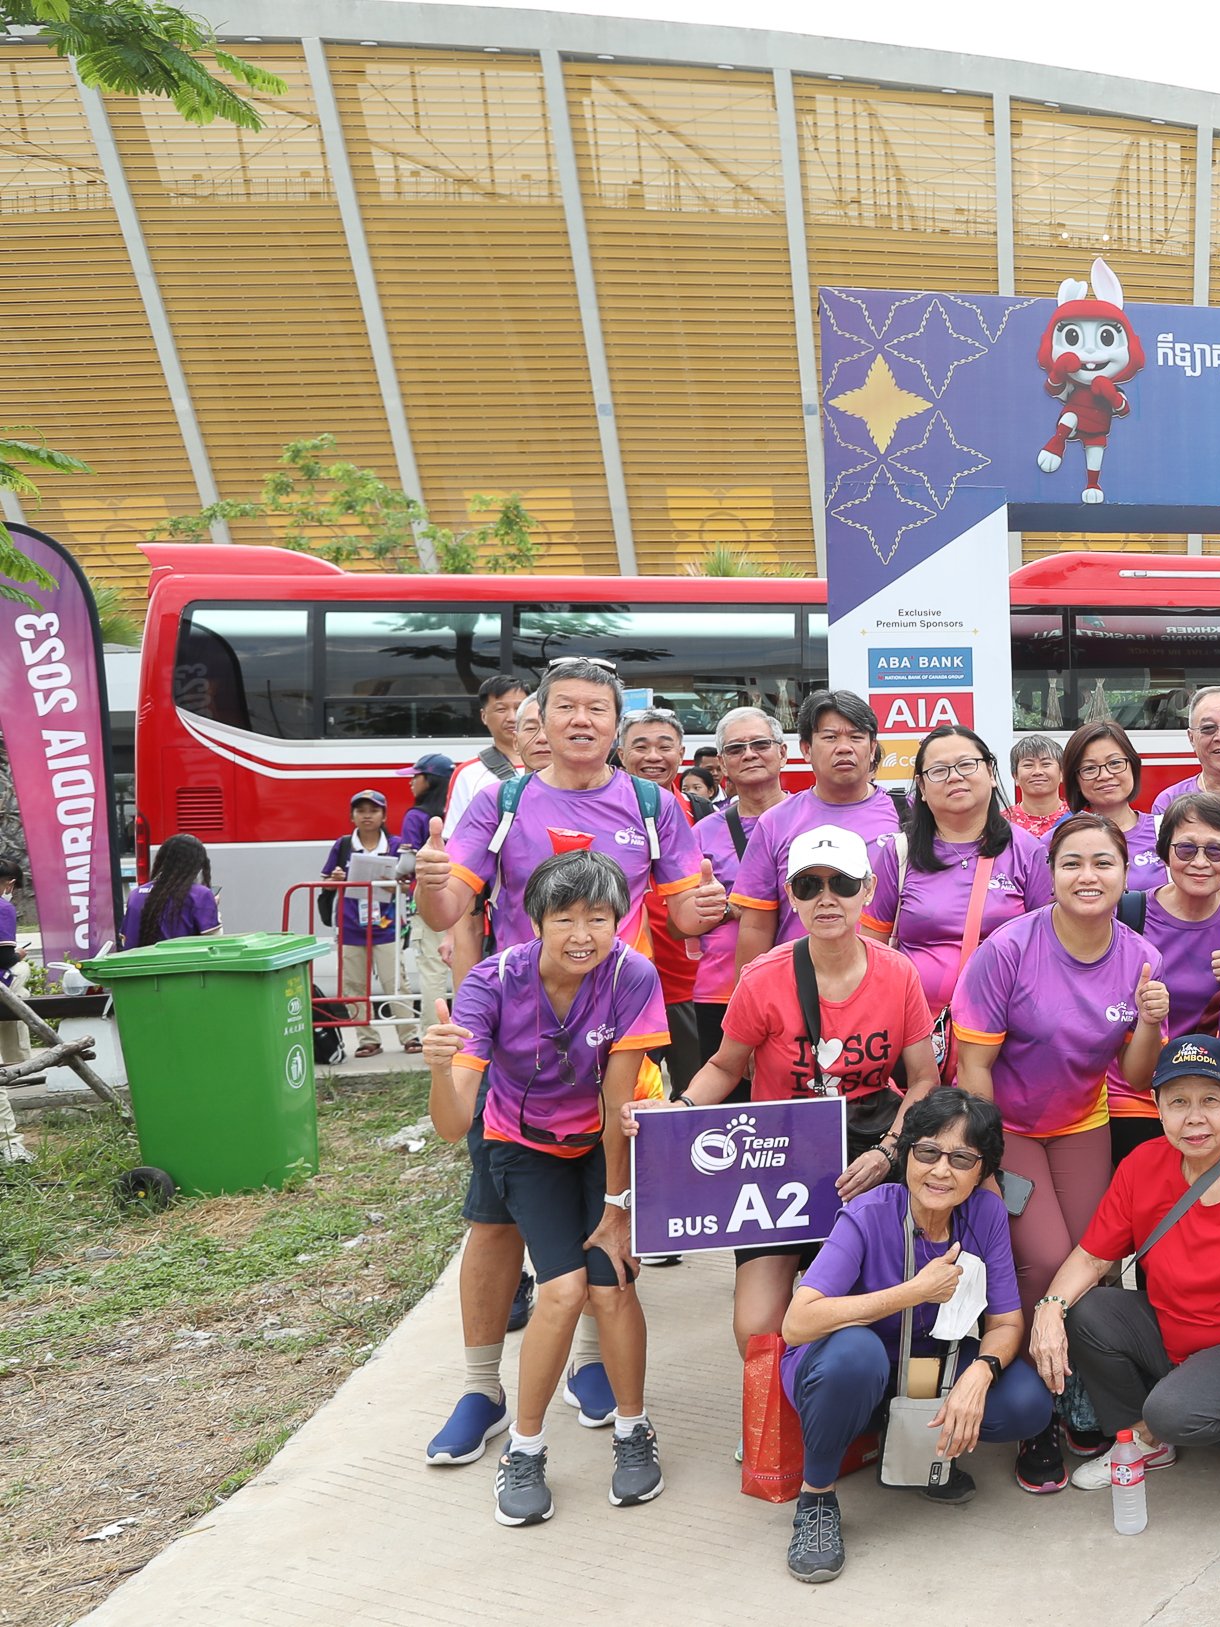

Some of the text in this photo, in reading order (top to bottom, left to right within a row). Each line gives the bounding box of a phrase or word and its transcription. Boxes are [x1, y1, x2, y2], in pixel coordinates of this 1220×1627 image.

[897, 608, 942, 617] Exclusive
[876, 619, 964, 629] Premium Sponsors
[918, 655, 964, 668] BANK
[884, 697, 960, 729] AIA
[792, 1029, 892, 1068] I SG
[1172, 1050, 1217, 1066] CAMBODIA
[790, 1071, 809, 1092] I
[742, 1136, 790, 1150] Team
[740, 1150, 786, 1170] Nila
[668, 1181, 810, 1238] BUS A2
